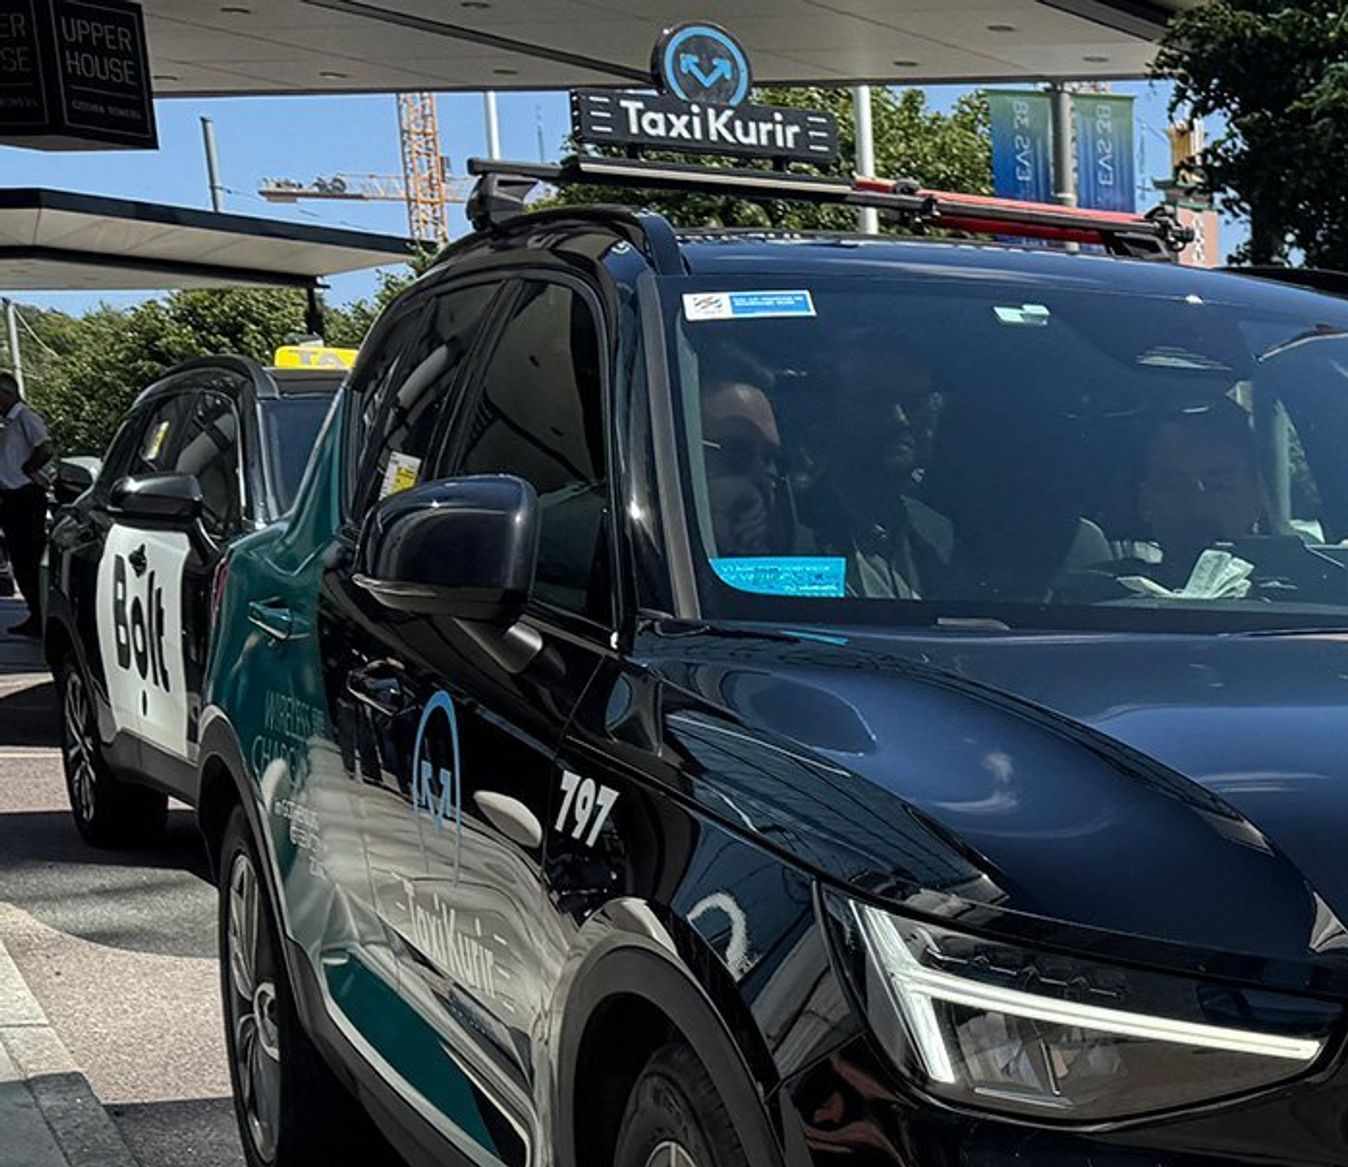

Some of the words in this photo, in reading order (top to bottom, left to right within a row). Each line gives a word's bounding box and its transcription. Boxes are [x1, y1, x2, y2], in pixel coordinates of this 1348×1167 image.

[60, 15, 133, 51] UPPER
[65, 50, 137, 86] HOUSE
[112, 553, 171, 693] Bolt
[554, 769, 621, 848] 797
